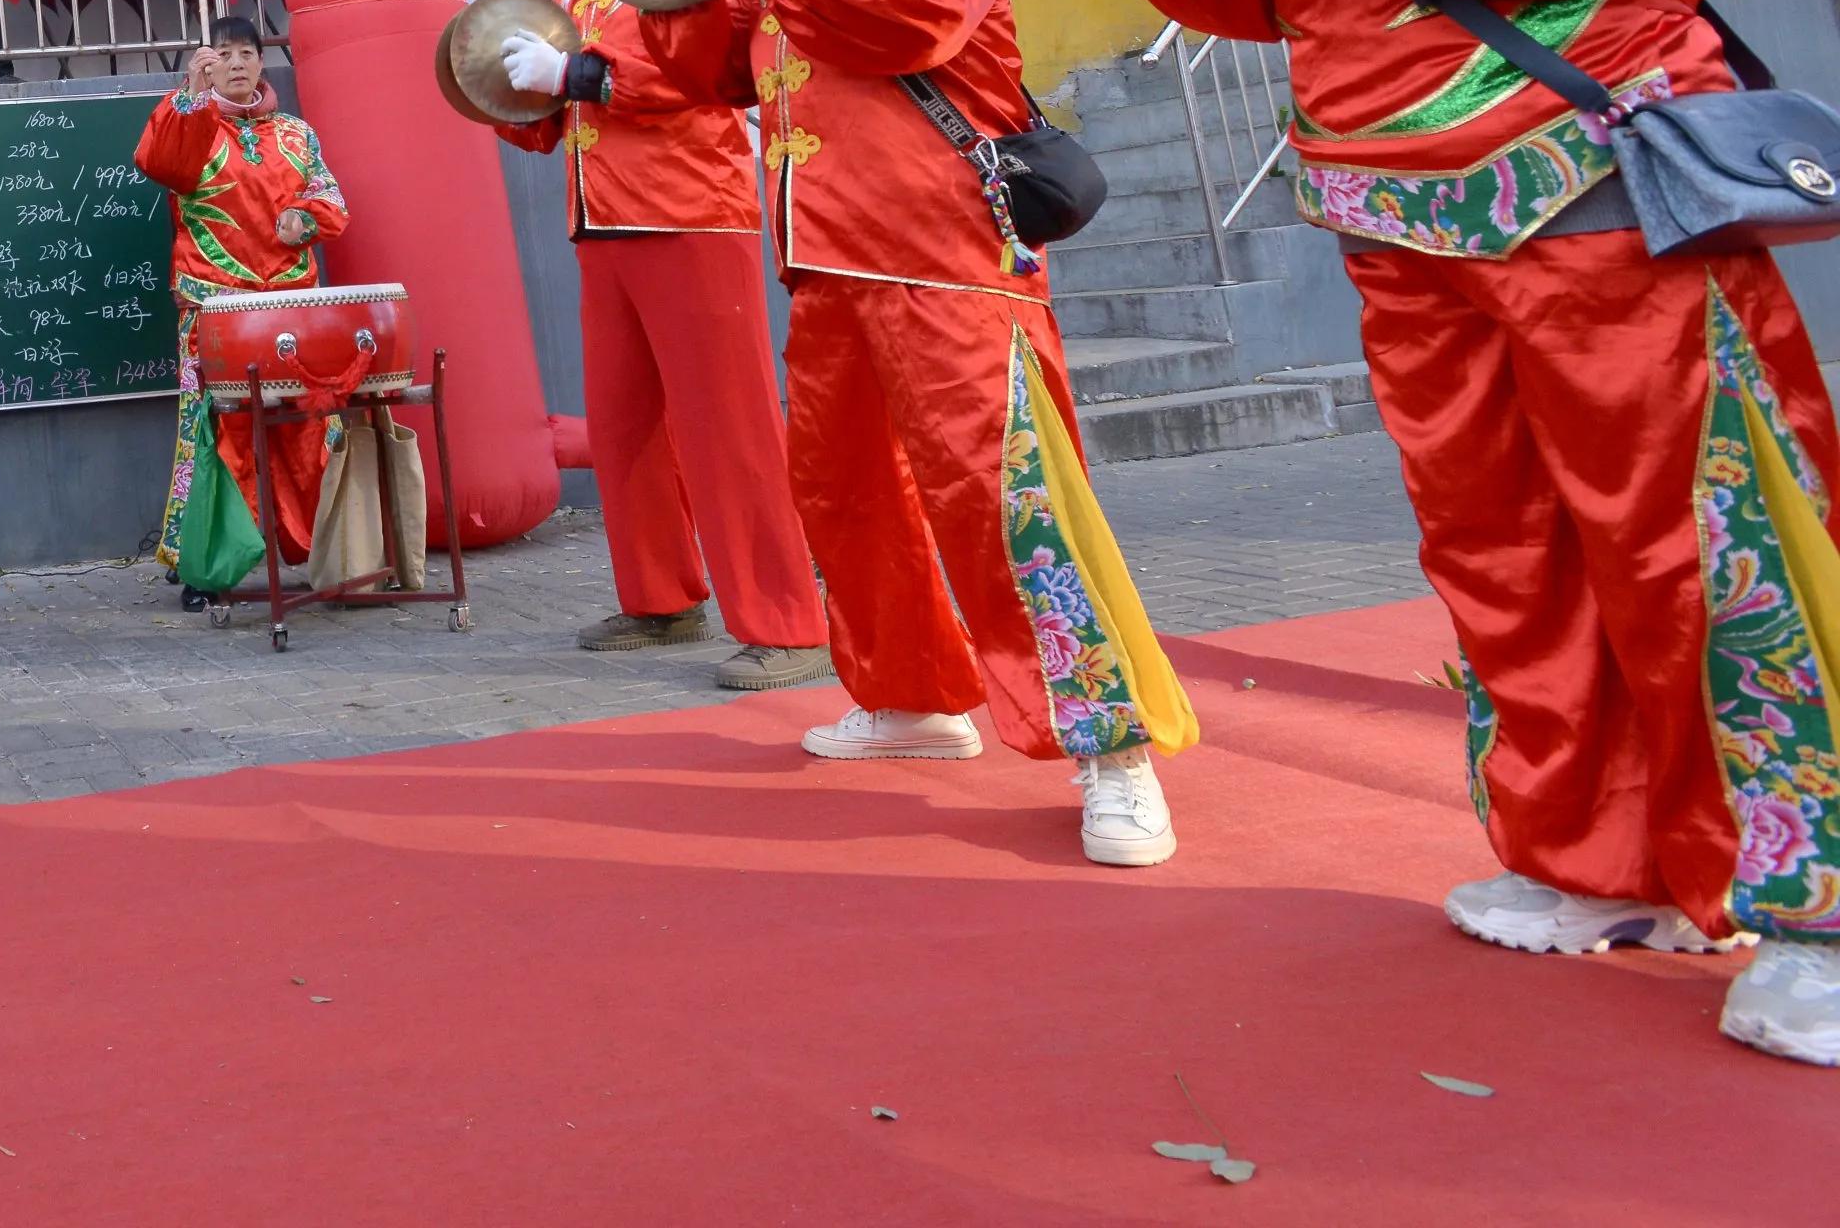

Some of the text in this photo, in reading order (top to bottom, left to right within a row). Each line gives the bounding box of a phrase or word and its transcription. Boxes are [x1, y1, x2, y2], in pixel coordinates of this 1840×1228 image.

[24, 109, 76, 129] 1680元
[7, 140, 60, 159] 258元
[0, 169, 55, 191] 1380元
[95, 164, 148, 189] 999元
[16, 199, 72, 226] 3380元
[92, 193, 144, 218] 2680元
[39, 237, 93, 261] 238元
[29, 307, 72, 335] 98元
[84, 296, 153, 331] 一日游
[14, 338, 79, 366] 一日游
